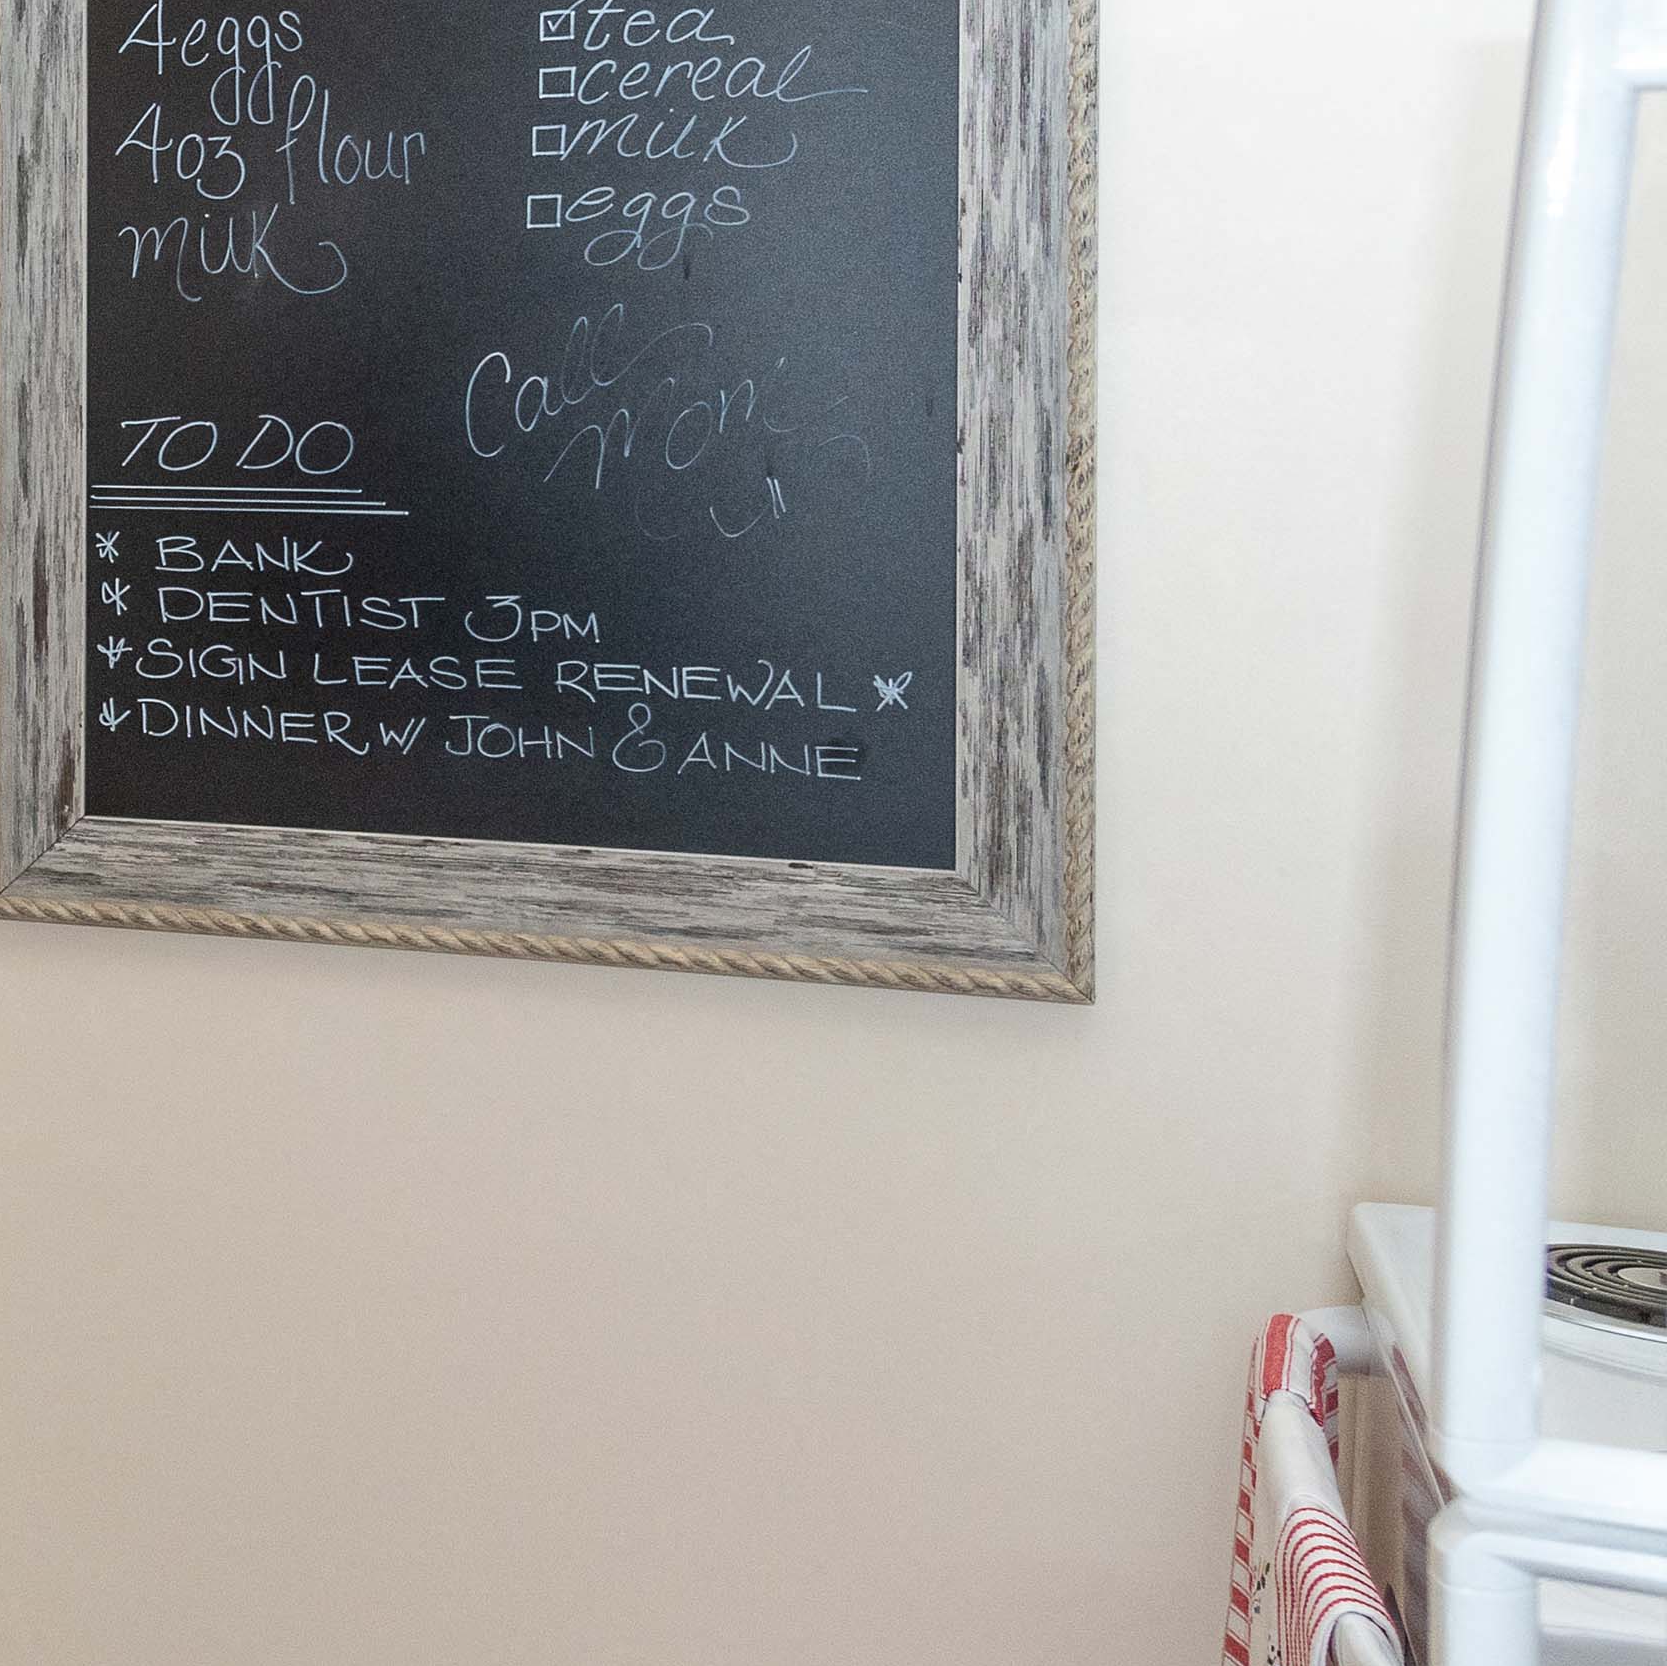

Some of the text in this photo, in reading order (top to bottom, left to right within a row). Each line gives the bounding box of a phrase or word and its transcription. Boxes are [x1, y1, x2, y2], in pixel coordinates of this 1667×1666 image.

[582, 0, 735, 51] tea
[577, 45, 869, 104] cereal
[274, 75, 427, 204] flour
[565, 185, 751, 271] eggs
[465, 302, 713, 458] Call
[120, 413, 355, 474] TO DO
[155, 535, 354, 576] BANK
[158, 588, 445, 631] DENTIST
[136, 640, 858, 713] SIGN LEASE RENEWAL
[137, 699, 370, 756] DINNER
[444, 714, 595, 761] JOHN
[676, 733, 862, 781] ANNE
